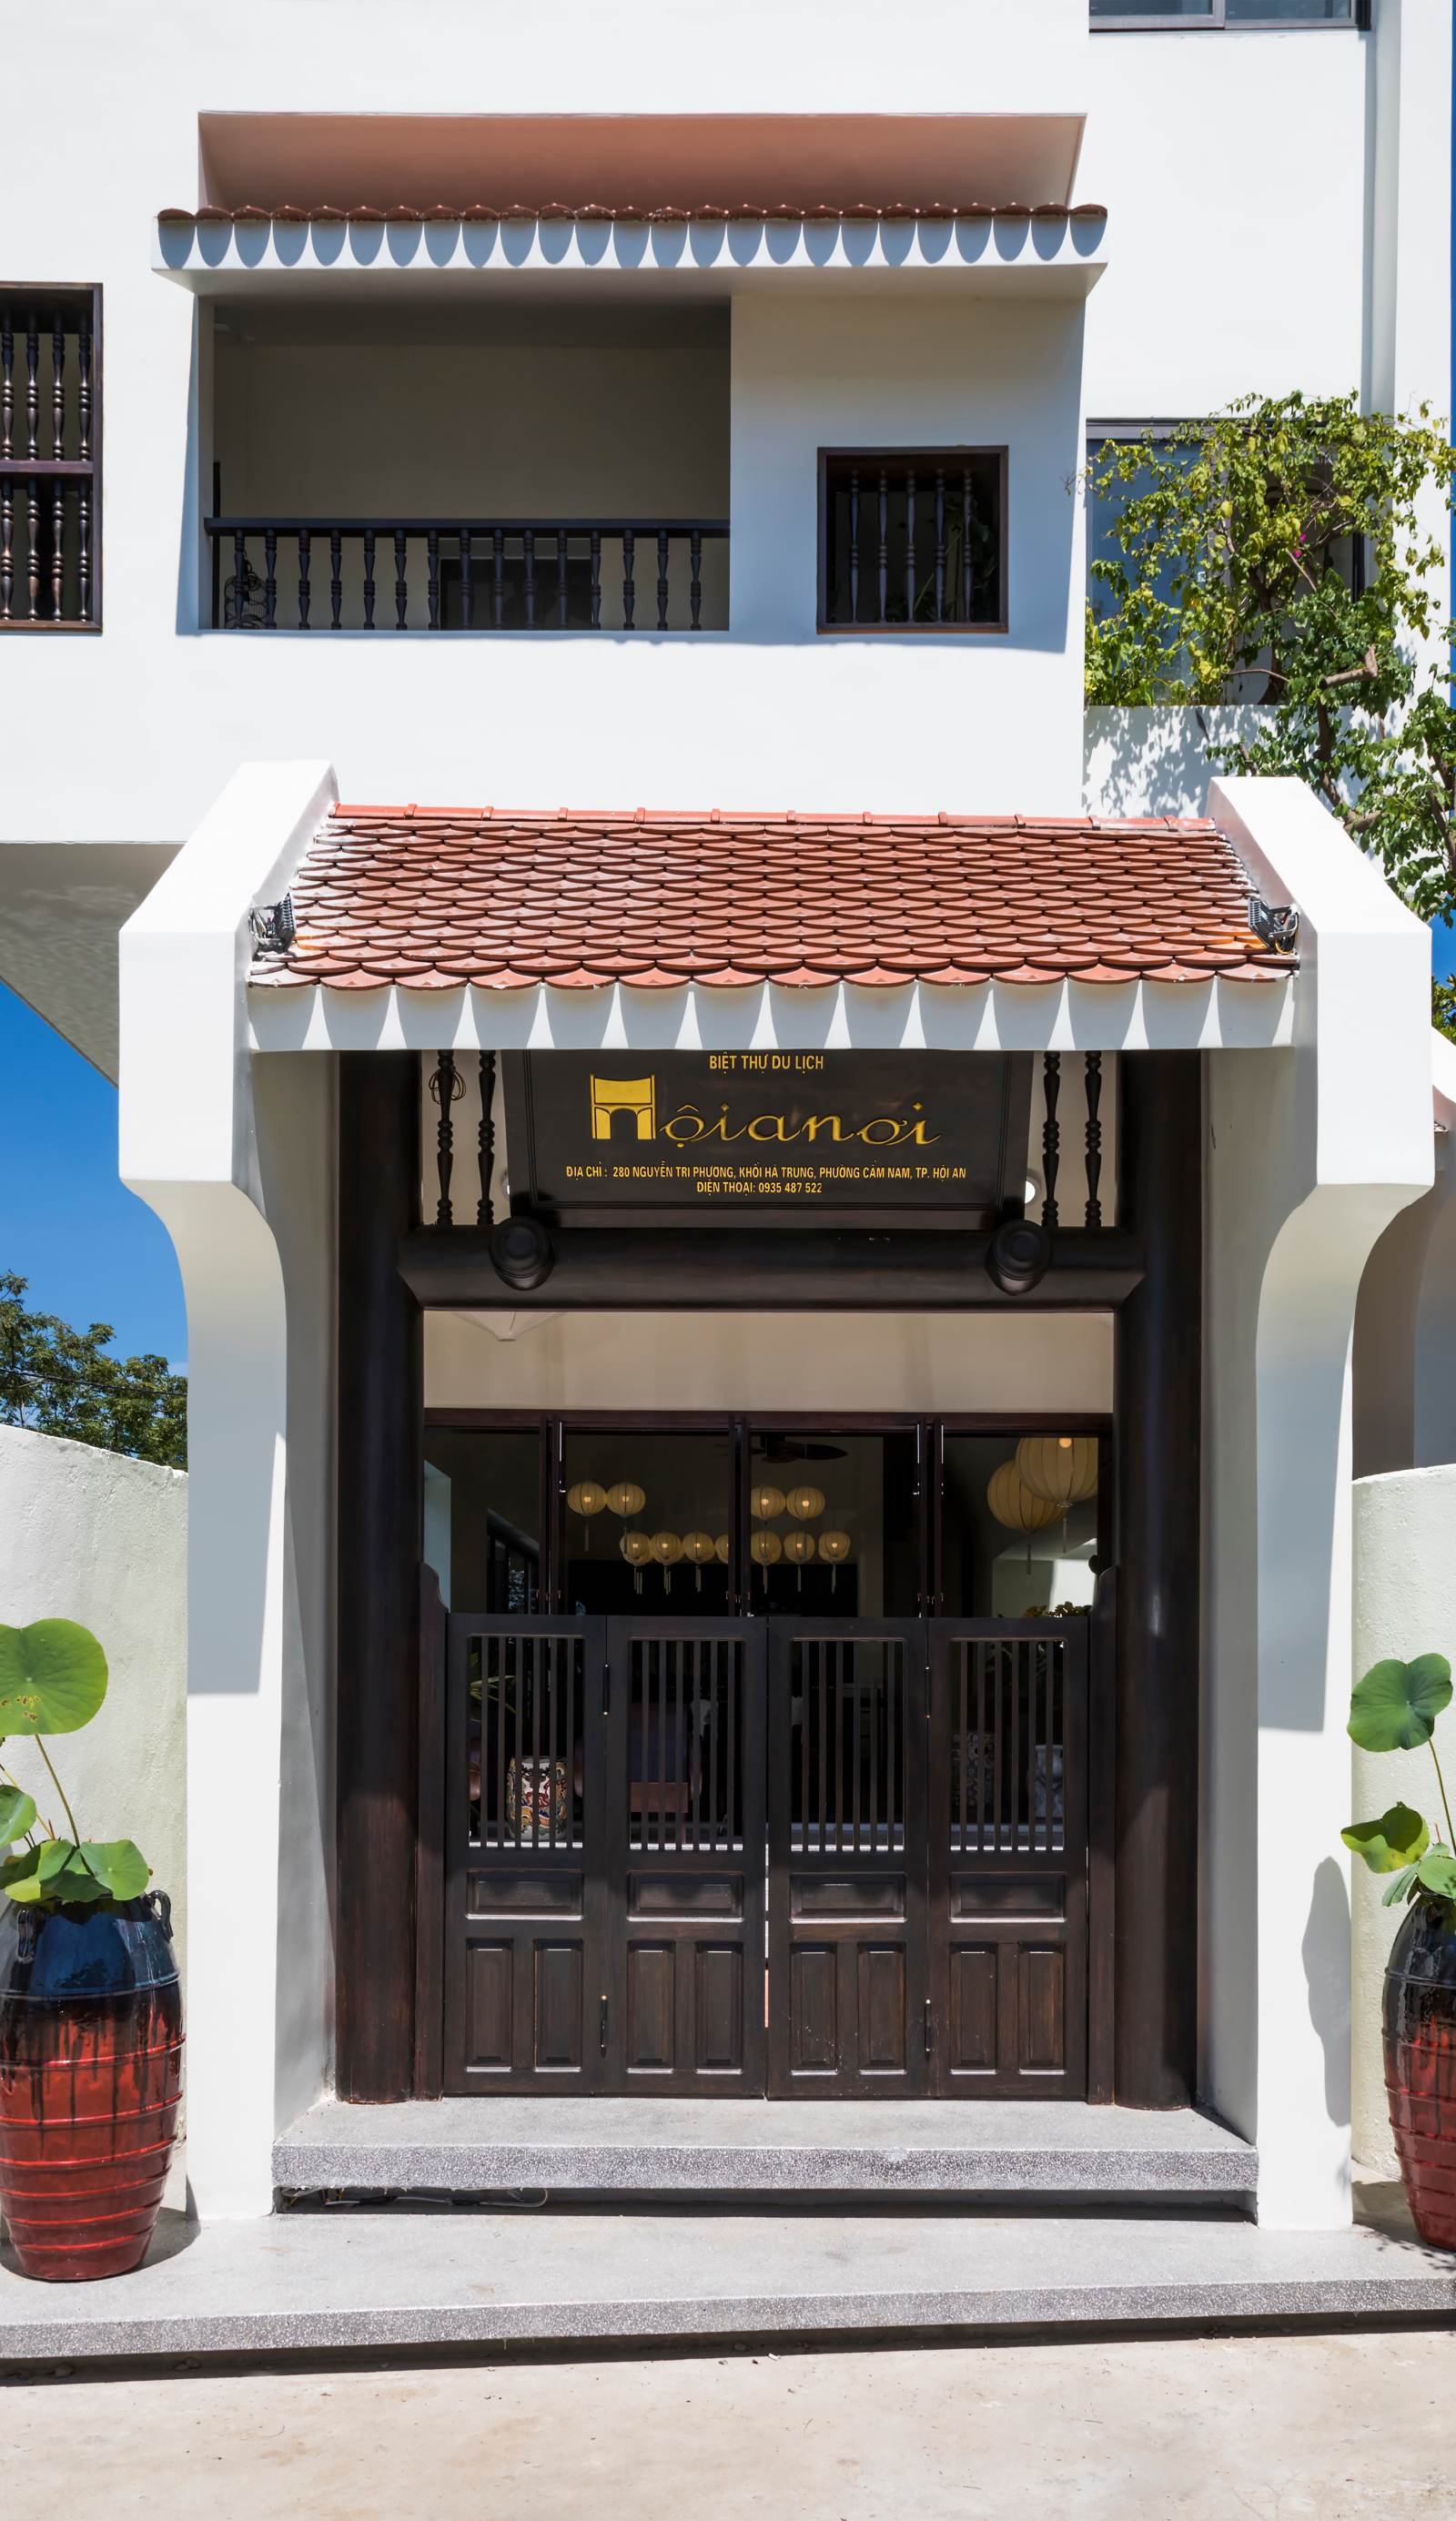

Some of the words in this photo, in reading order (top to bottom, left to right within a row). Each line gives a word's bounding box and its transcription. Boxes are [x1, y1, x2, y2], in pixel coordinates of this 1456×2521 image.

[709, 1051, 737, 1074] BIỆT
[741, 1053, 769, 1074] THỰ
[772, 1055, 791, 1069] DU
[794, 1055, 824, 1074] LỊCH
[566, 1166, 583, 1180] ĐỊA
[612, 1166, 630, 1178] 280
[632, 1160, 673, 1178] NGUYỄN
[675, 1166, 691, 1178] TRI
[693, 1165, 736, 1180] PHƯƠNG,
[781, 1166, 817, 1180] TRUNG,
[887, 1167, 913, 1180] NAM,
[915, 1167, 930, 1179] TP.
[933, 1164, 949, 1182] HỘI
[952, 1167, 966, 1179] AN
[696, 1179, 720, 1196] ĐIỆN
[723, 1182, 756, 1196] THOẠI:
[758, 1182, 782, 1193] 0935
[784, 1182, 802, 1193] 487
[804, 1182, 823, 1193] 522
